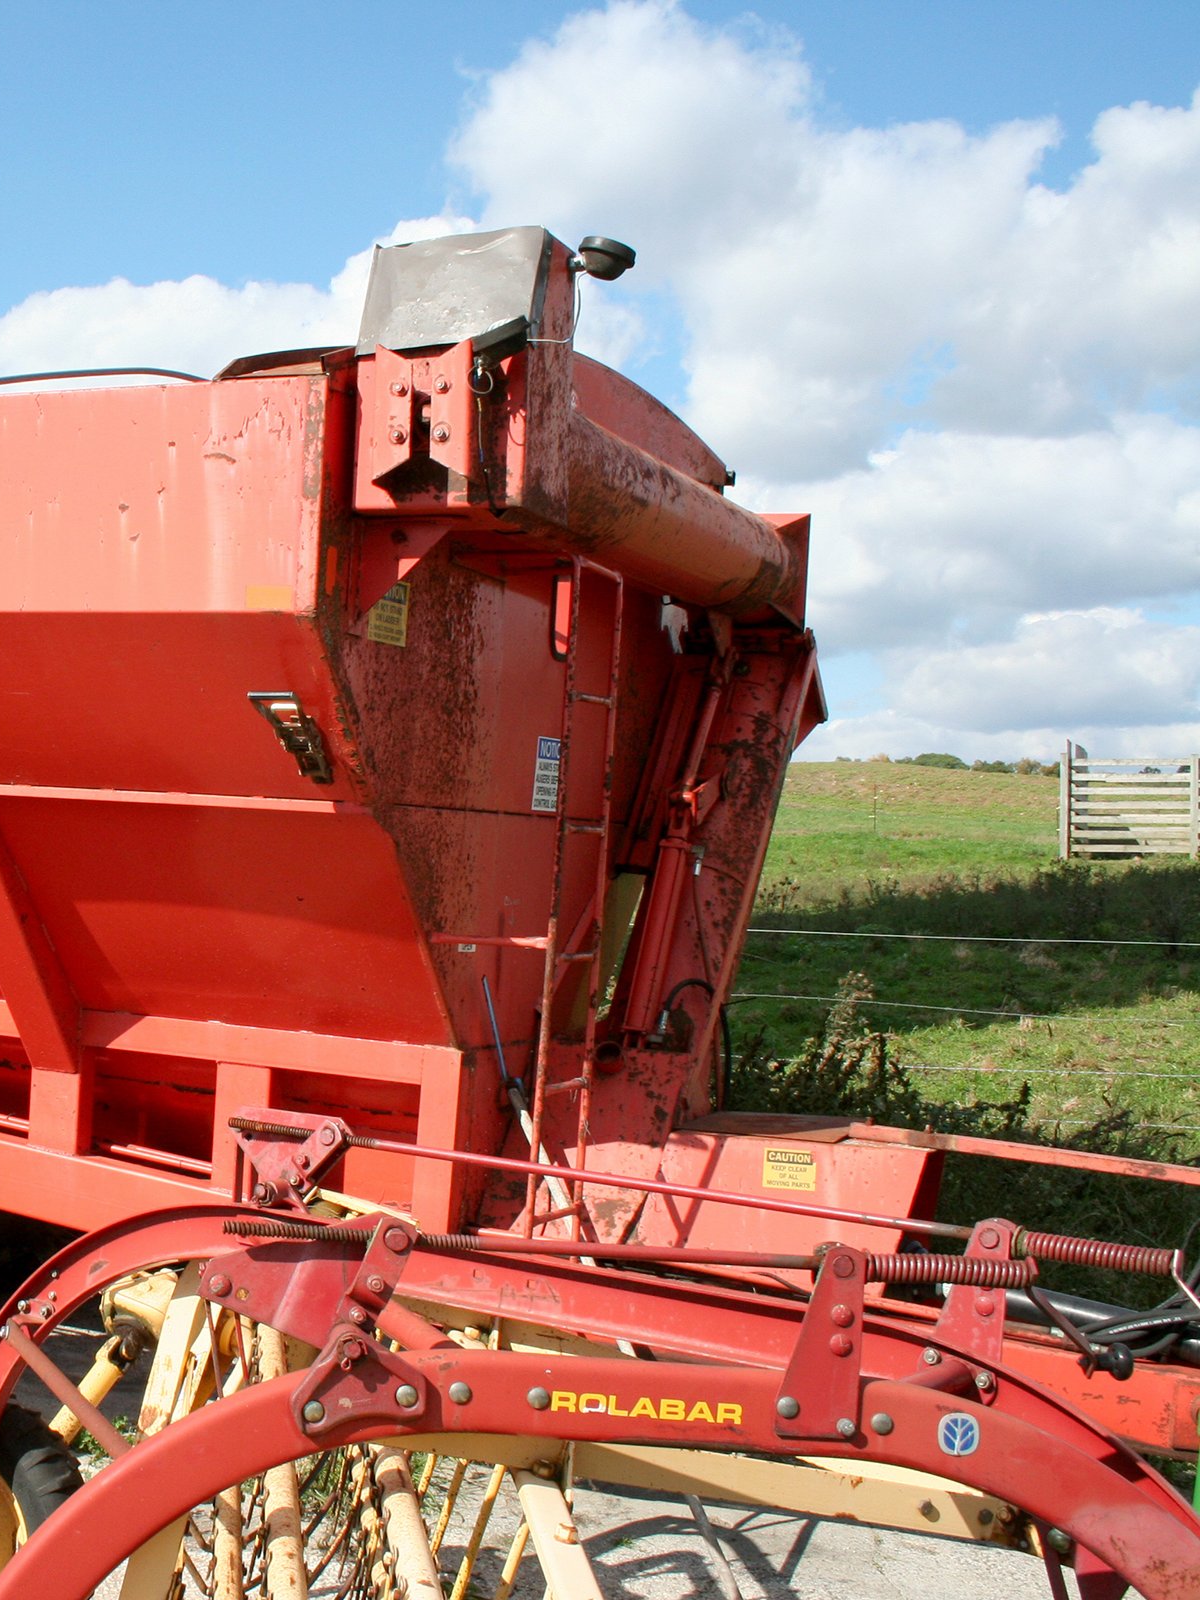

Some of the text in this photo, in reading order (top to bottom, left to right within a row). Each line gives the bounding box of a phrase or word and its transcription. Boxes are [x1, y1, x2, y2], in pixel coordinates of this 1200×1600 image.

[540, 740, 561, 759] NOTIC
[768, 1152, 811, 1163] CAUTION
[787, 1165, 807, 1173] CLEAR
[791, 1181, 810, 1189] PARTS
[550, 1391, 743, 1425] ROLABAR
